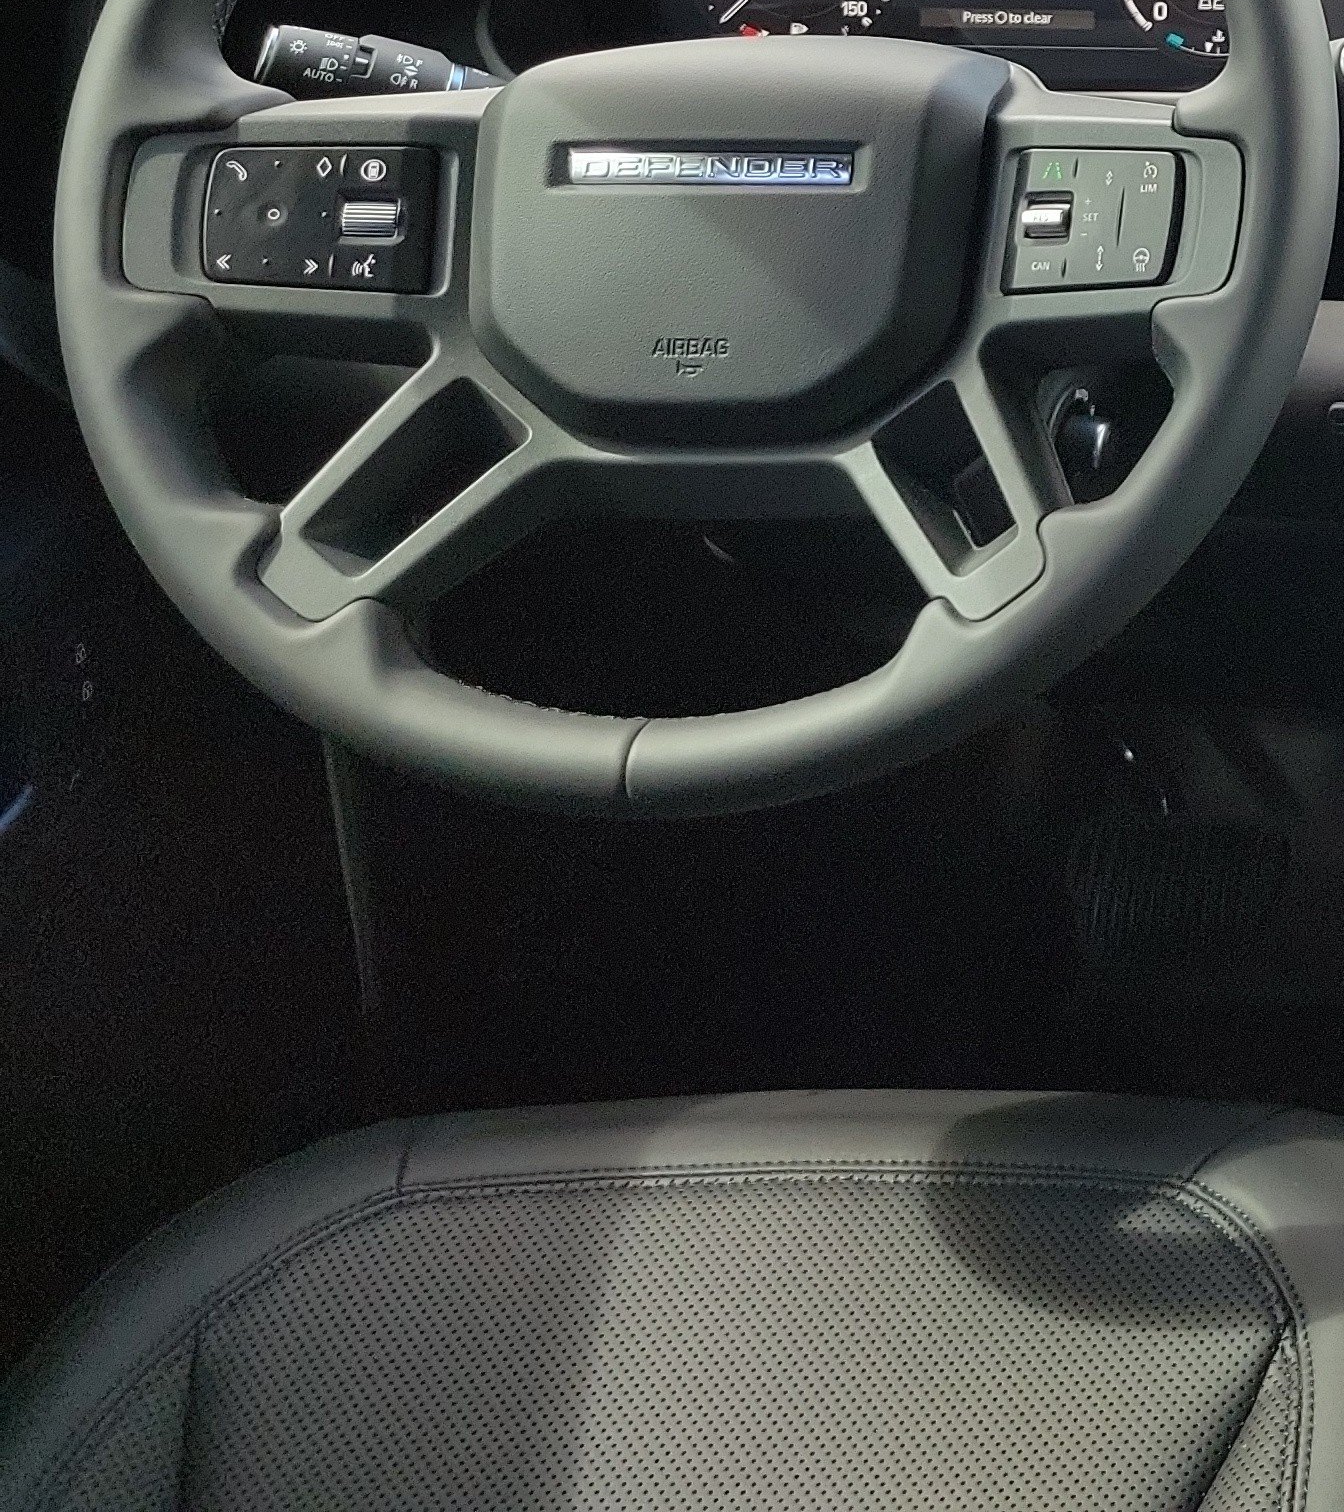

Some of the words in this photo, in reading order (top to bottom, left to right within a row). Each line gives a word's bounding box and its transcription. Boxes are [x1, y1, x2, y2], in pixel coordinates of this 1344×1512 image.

[842, 1, 867, 17] 150
[1153, 2, 1168, 21] 0
[963, 11, 993, 24] Press
[1009, 13, 1022, 24] to
[1024, 11, 1053, 24] clear
[303, 68, 335, 82] AUTO
[410, 79, 418, 89] R
[582, 156, 842, 179] DEFENDER
[1140, 184, 1157, 193] LIM
[1083, 212, 1099, 222] SET
[1031, 261, 1050, 271] CAN
[652, 337, 729, 357] AIRBAG
